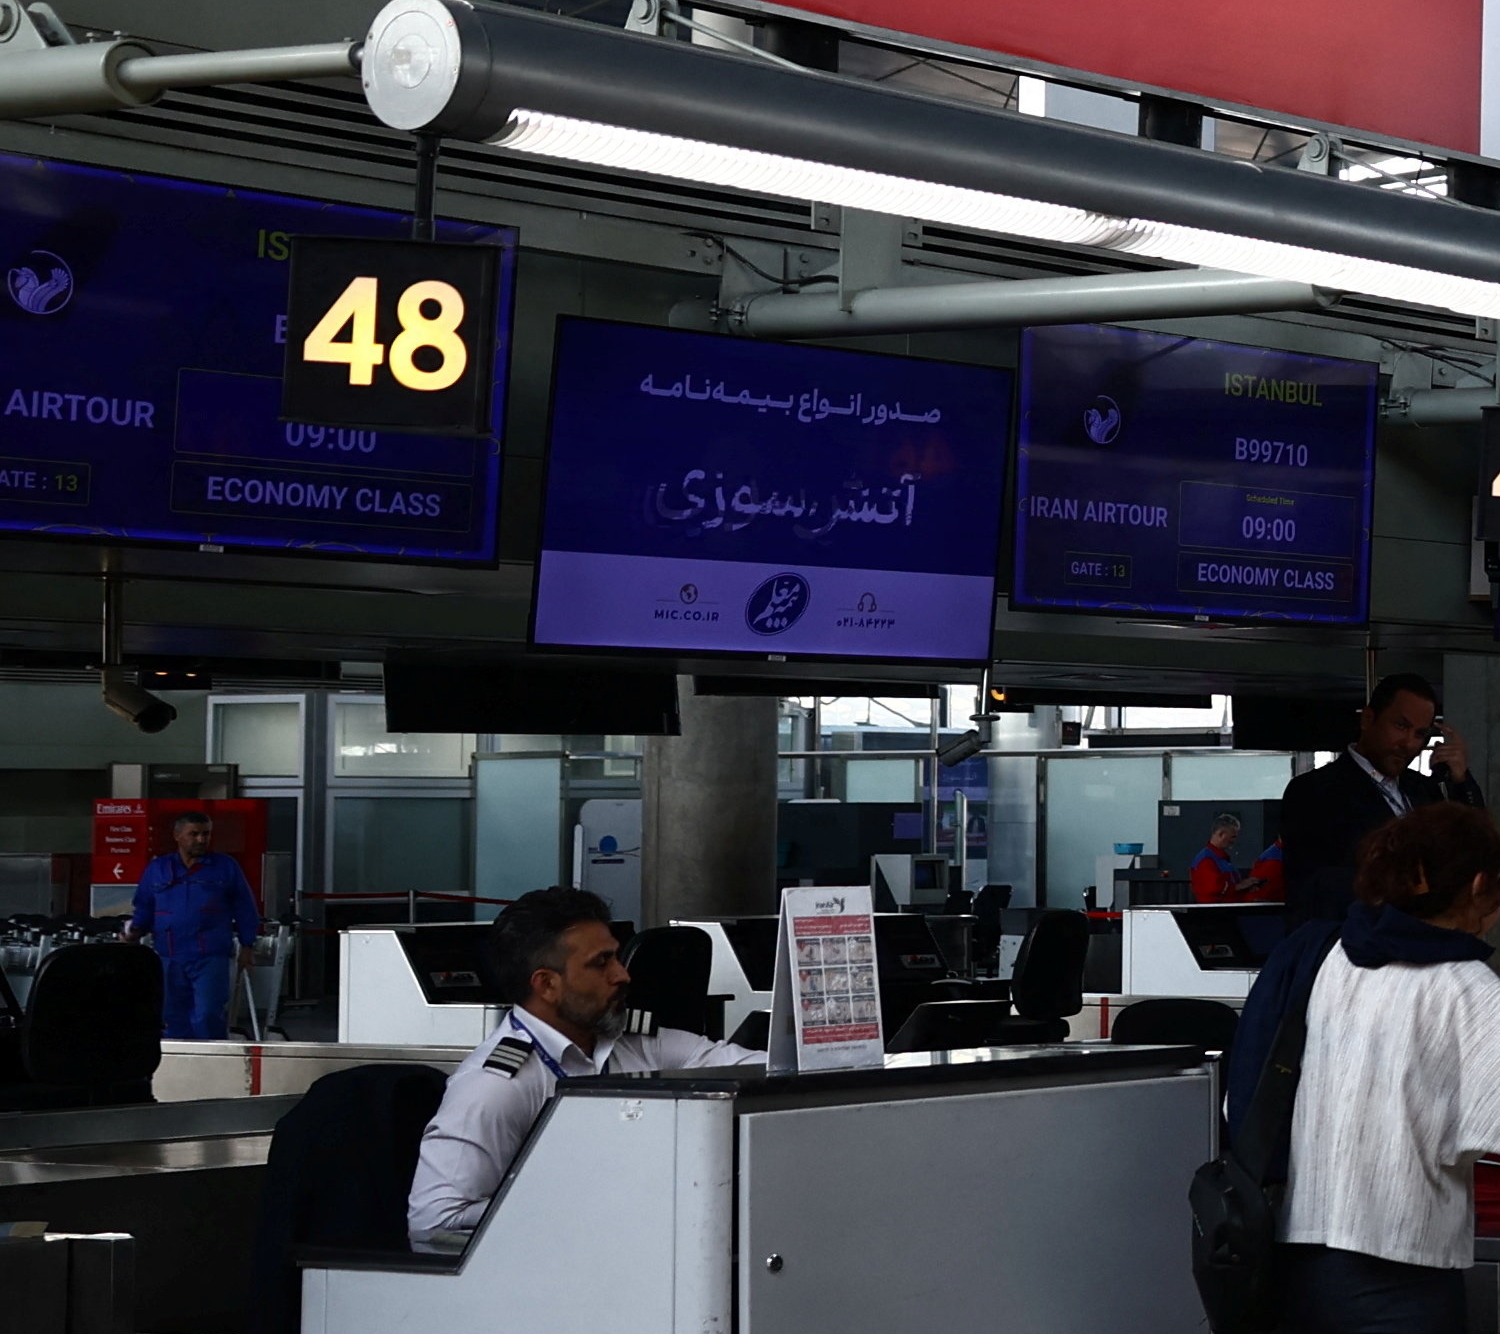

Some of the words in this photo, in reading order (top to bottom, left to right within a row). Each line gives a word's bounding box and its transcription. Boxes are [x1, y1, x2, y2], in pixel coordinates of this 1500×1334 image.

[303, 276, 468, 392] 48
[799, 387, 862, 423] انواع
[1223, 371, 1324, 408] ISTANBUL
[4, 387, 156, 430] AIRTOUR
[862, 395, 942, 426] صدور
[1234, 436, 1309, 468] B99710
[54, 474, 79, 493] 13
[206, 475, 349, 510] ECONOMY
[355, 486, 442, 518] CLASS
[1029, 495, 1079, 522] IRAN
[1083, 499, 1169, 529] AIRTOUR
[1241, 515, 1297, 543] 09:00
[1112, 564, 1126, 579] 13
[1197, 561, 1280, 588] ECONOMY
[1283, 568, 1336, 592] CLASS
[653, 609, 720, 622] MIC.CO.IR
[96, 803, 132, 815] Emirates
